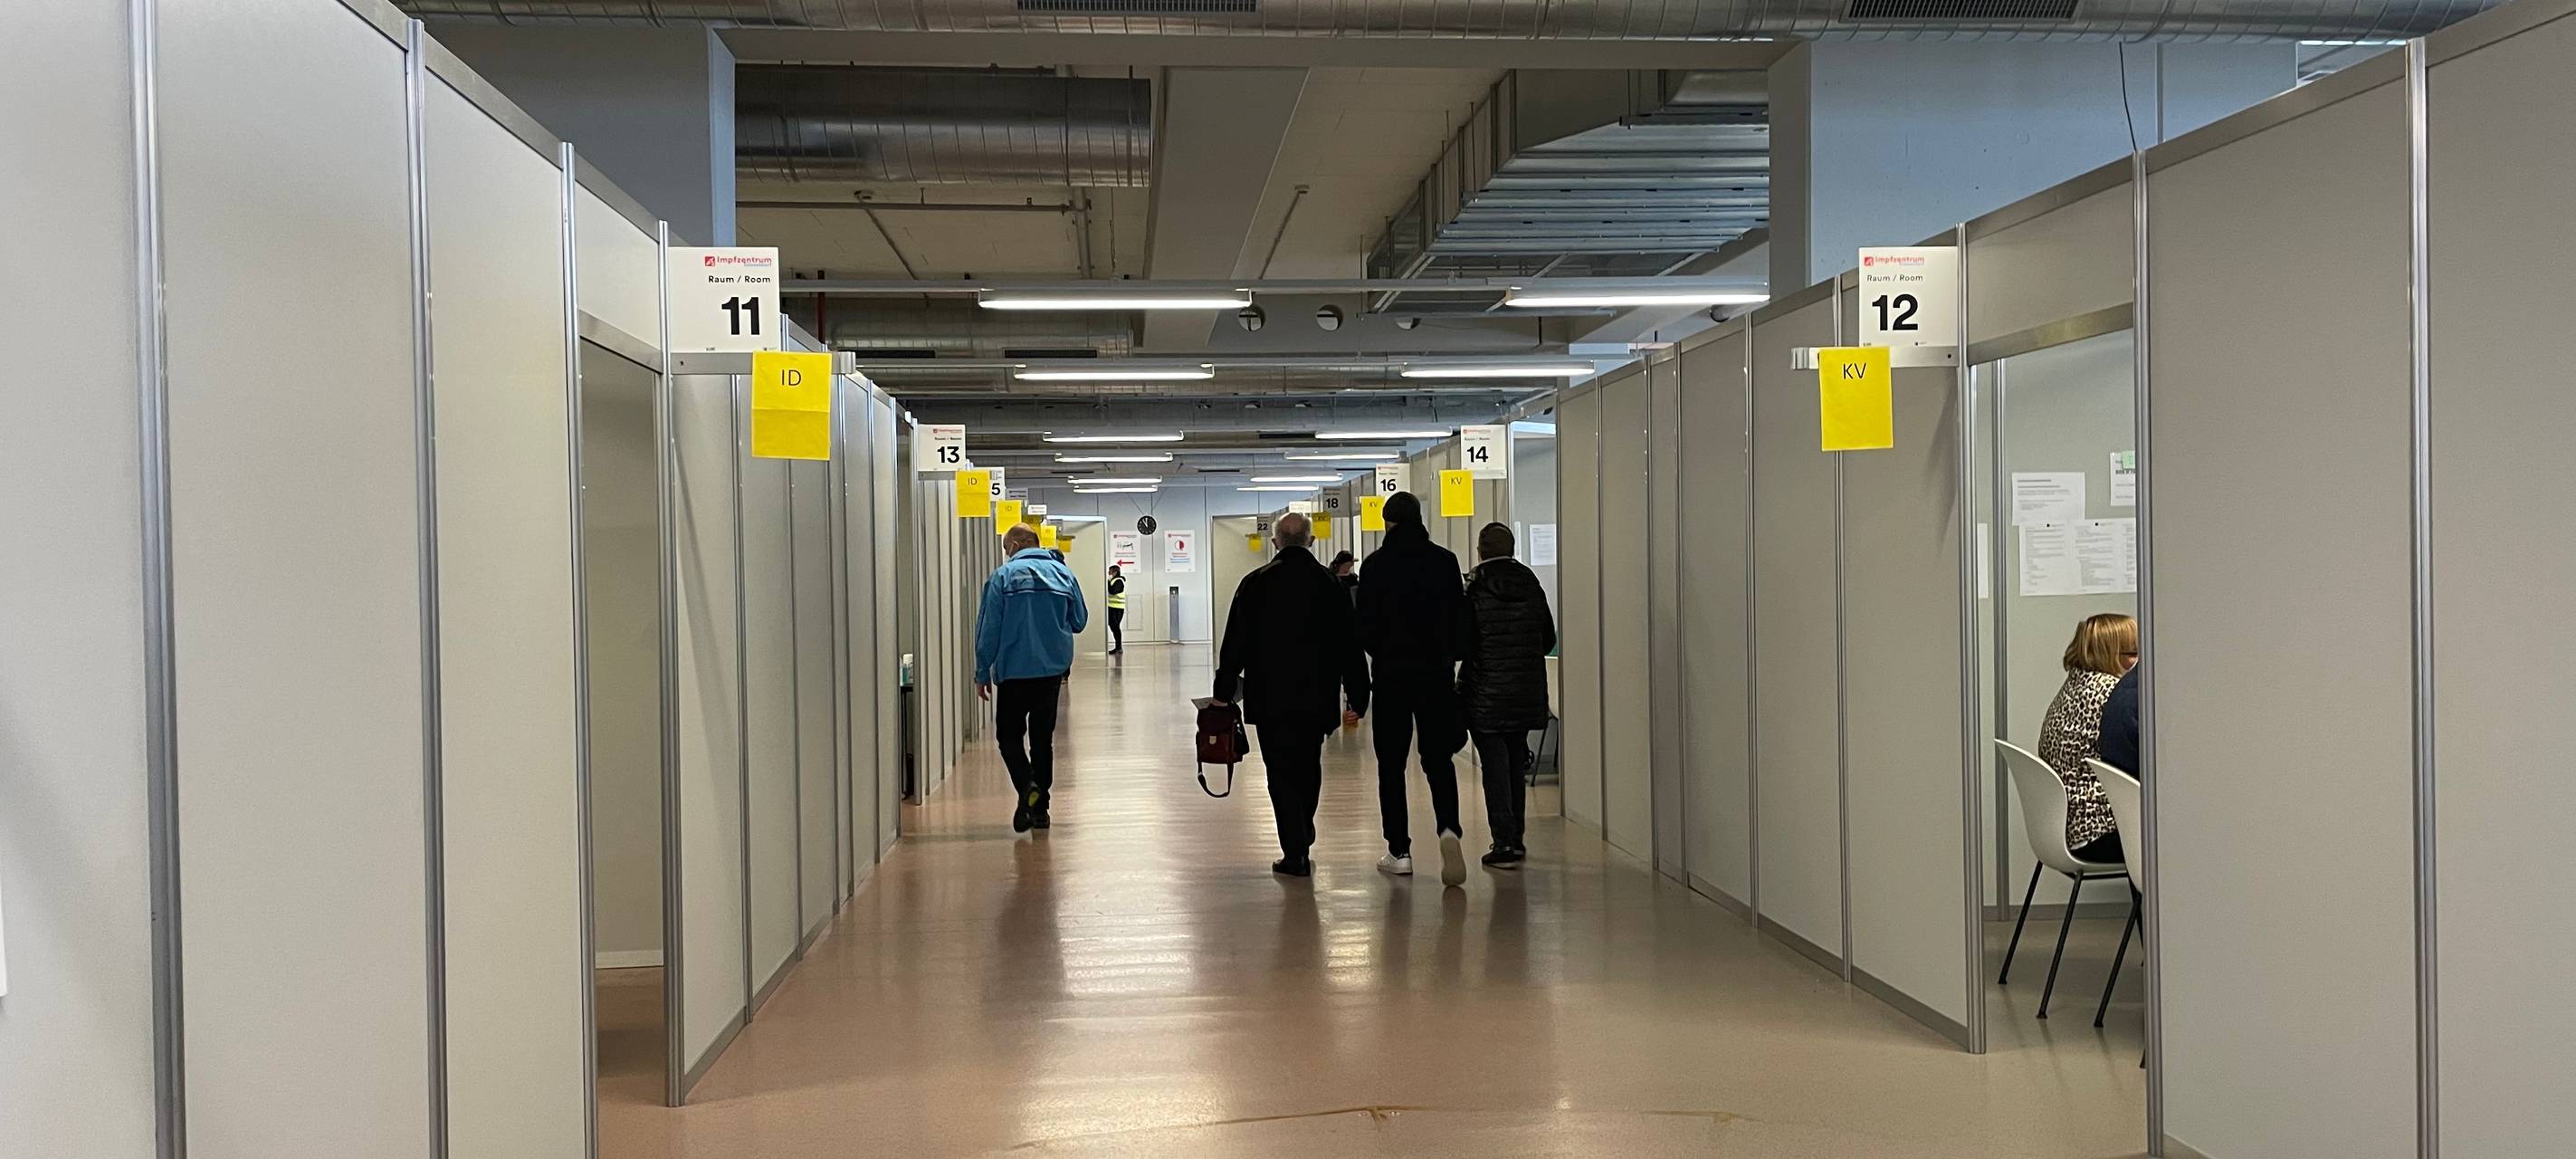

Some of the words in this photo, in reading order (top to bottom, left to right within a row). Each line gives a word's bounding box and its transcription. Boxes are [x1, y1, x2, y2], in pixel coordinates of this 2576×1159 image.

[717, 256, 772, 264] Impfzentrum
[1875, 256, 1924, 264] Impfzentrum
[708, 274, 734, 283] Raum
[744, 274, 771, 283] Room
[720, 296, 761, 336] 11
[1871, 293, 1919, 331] 12
[781, 369, 802, 387] ID
[1843, 363, 1867, 380] KV
[937, 445, 960, 464] 13
[1466, 445, 1489, 463] 14
[968, 477, 978, 485] ID
[1380, 478, 1397, 492] 16
[1450, 477, 1463, 485] KV
[991, 483, 1001, 496] 5
[1325, 498, 1339, 509] 18
[1257, 522, 1268, 531] 22
